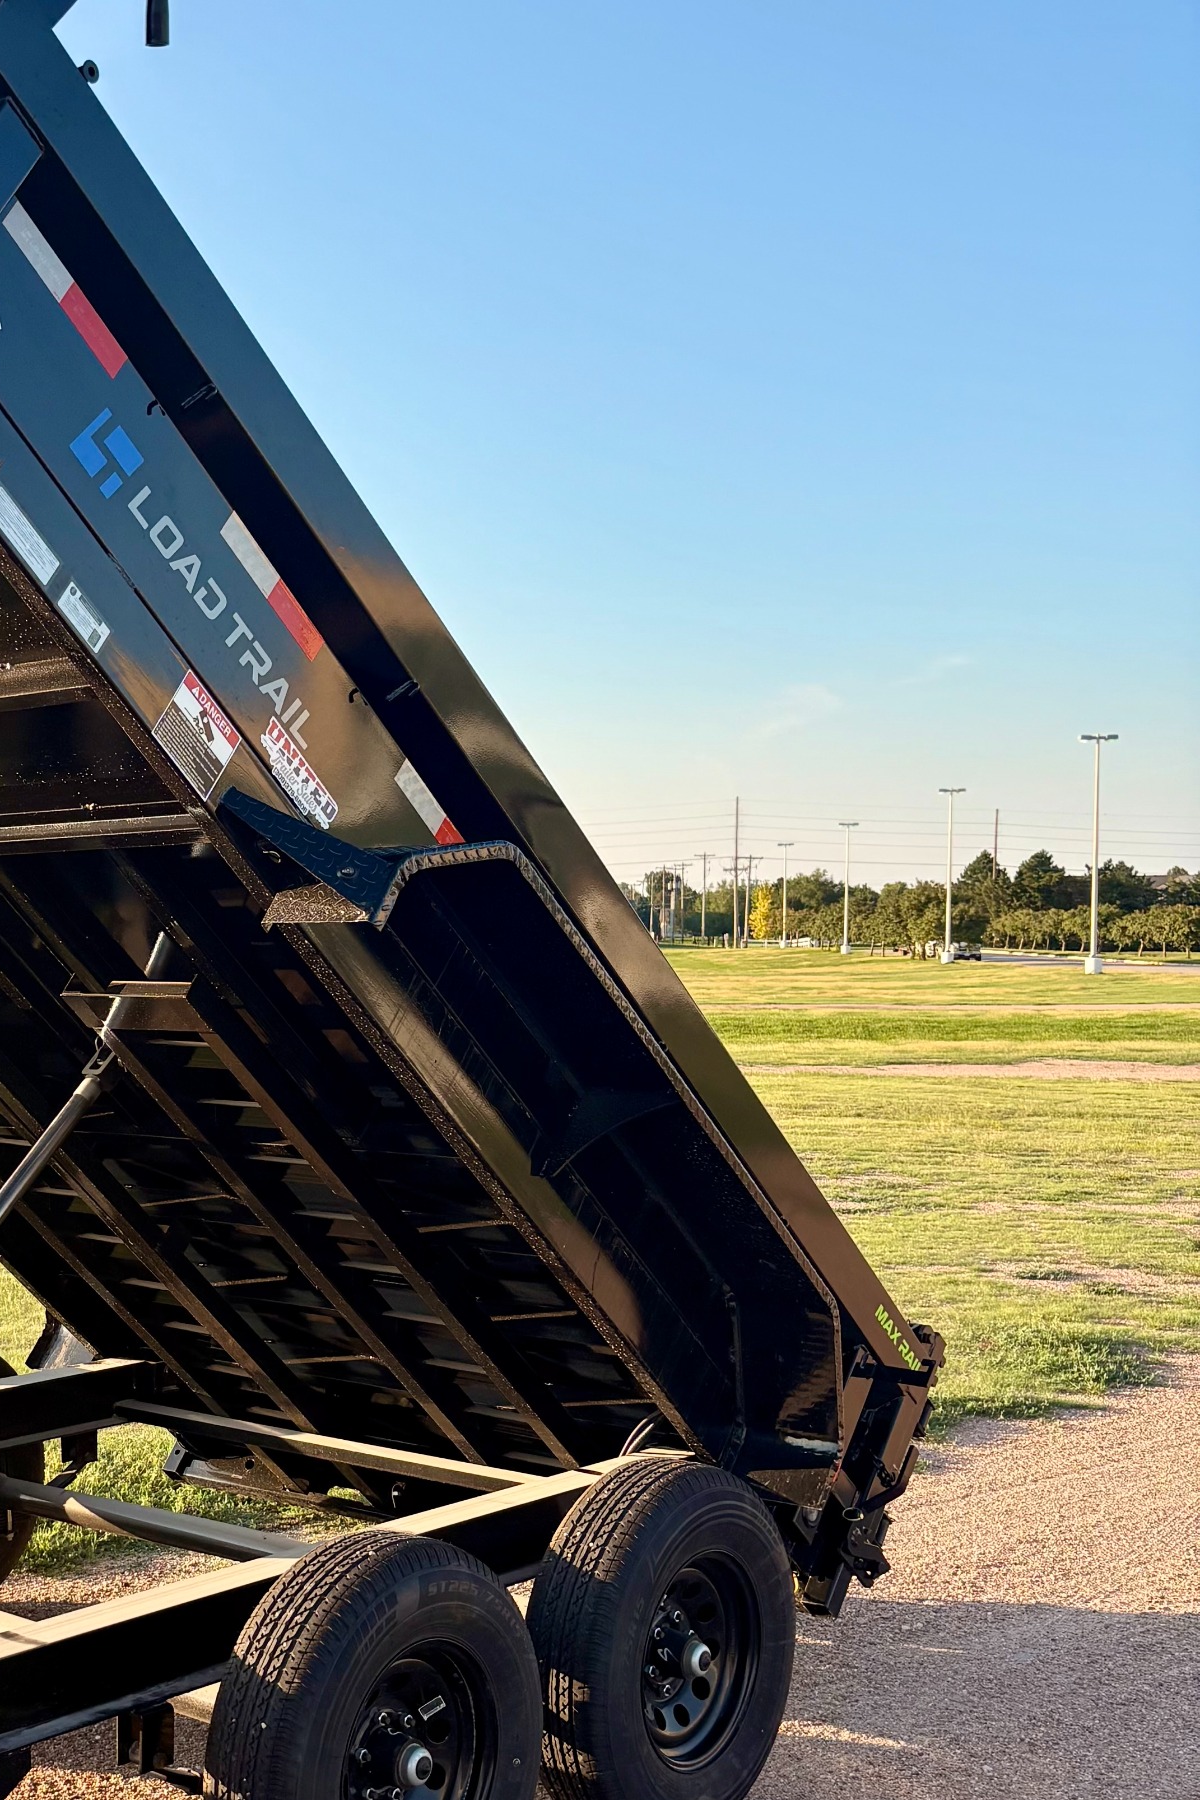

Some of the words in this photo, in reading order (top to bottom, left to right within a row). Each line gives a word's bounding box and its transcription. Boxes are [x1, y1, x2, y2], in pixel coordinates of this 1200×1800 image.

[127, 485, 228, 620] LOAD
[224, 612, 311, 750] TRAIL
[199, 694, 232, 738] DANGER
[266, 720, 337, 821] UNITED
[272, 750, 300, 786] Trailer
[296, 782, 318, 812] Sales
[874, 1303, 902, 1346] MAX
